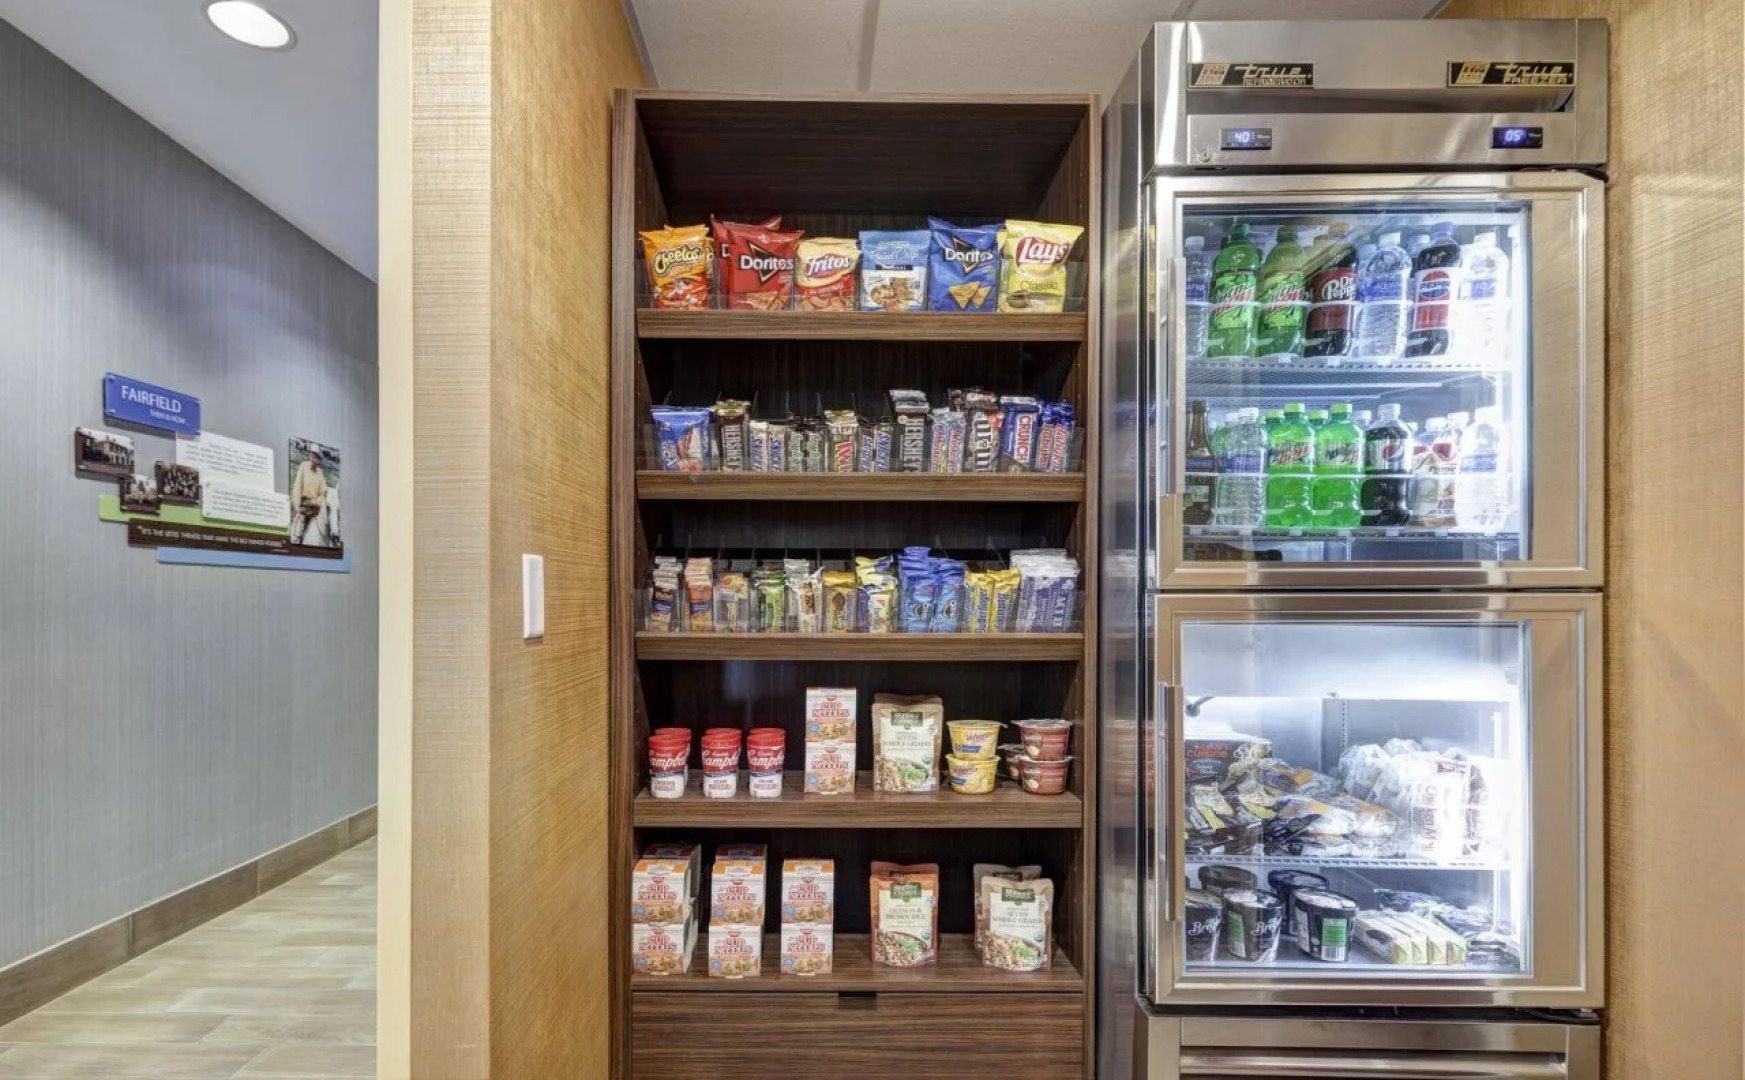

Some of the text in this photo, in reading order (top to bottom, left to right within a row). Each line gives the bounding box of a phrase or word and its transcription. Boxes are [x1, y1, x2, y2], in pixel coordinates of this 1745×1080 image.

[653, 244, 701, 276] Cheetos
[741, 254, 794, 271] Doritos
[805, 254, 850, 276] Fritos
[945, 246, 994, 263] Doritos
[1020, 280, 1058, 291] Classic
[1327, 280, 1354, 300] Pepp
[122, 385, 182, 413] FAIRFIELD
[725, 425, 741, 466] HERSHEY
[1015, 415, 1031, 460] CRUNCH
[770, 437, 781, 472] SNICKE
